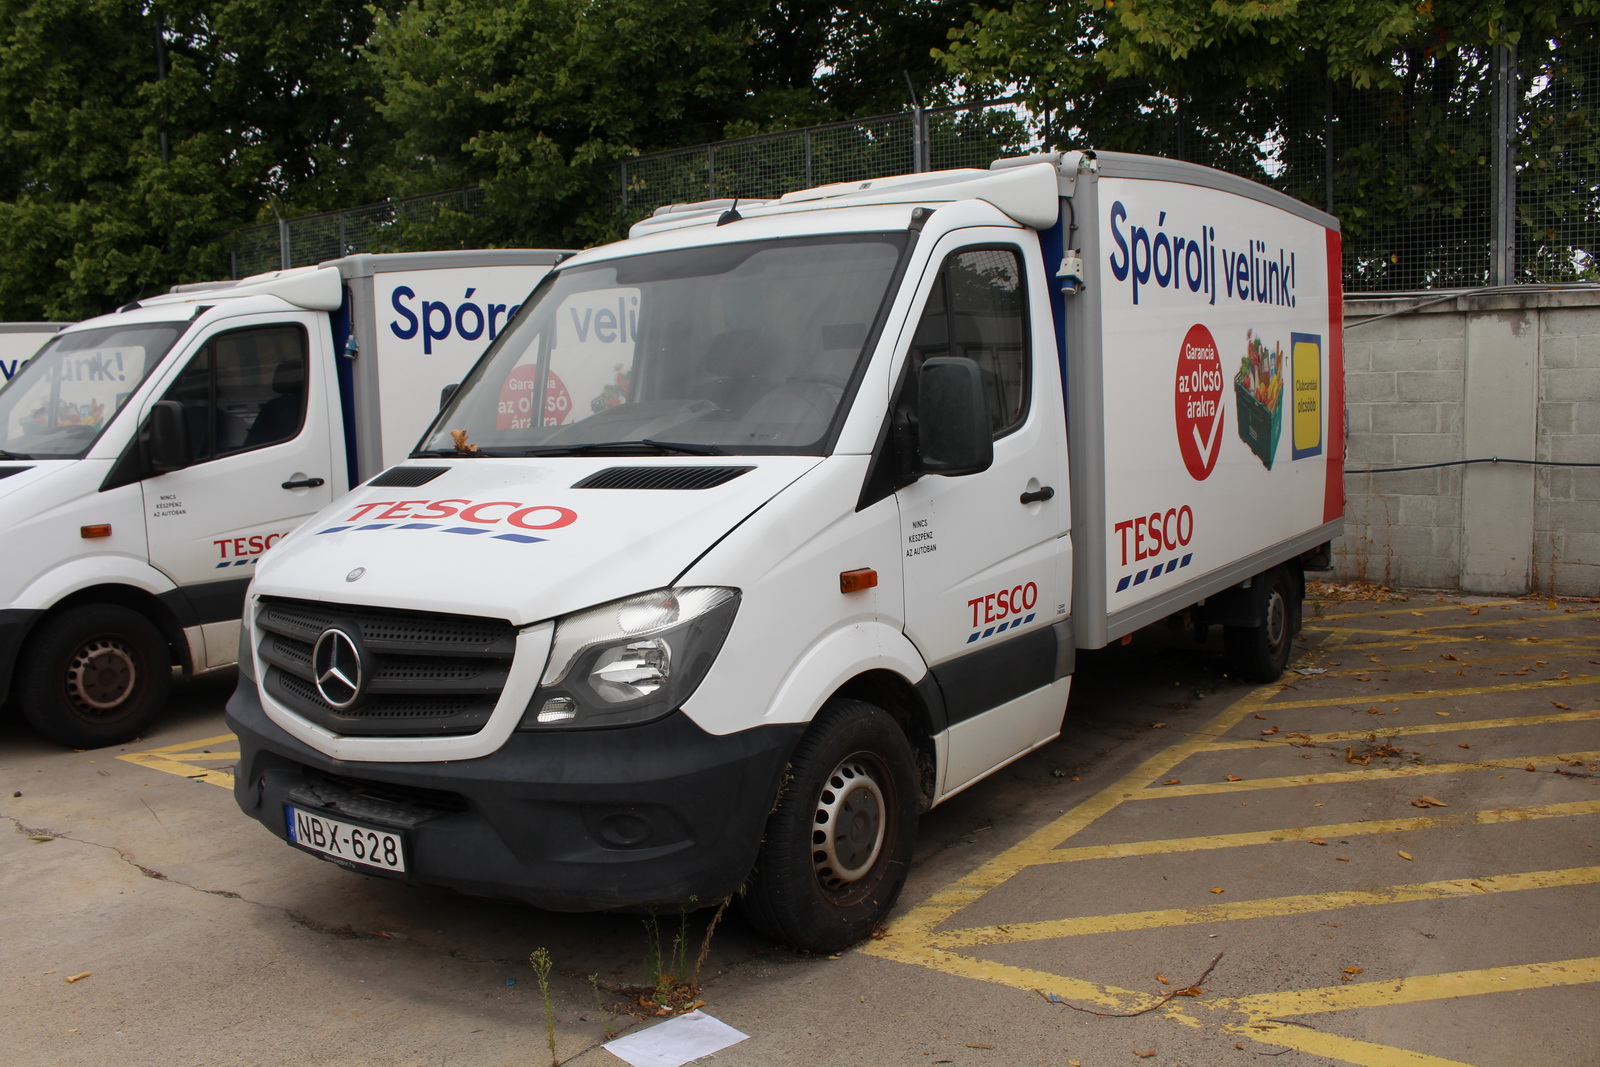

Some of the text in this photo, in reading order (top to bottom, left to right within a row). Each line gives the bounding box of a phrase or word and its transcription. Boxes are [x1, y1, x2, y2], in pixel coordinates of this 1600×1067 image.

[1110, 201, 1296, 308] Spórolj velünk!
[1185, 343, 1214, 360] Garancia
[509, 377, 556, 391] Garaia
[1179, 363, 1221, 393] az olcsó
[498, 390, 568, 414] az olsó
[1187, 395, 1215, 419] árakra
[511, 415, 558, 430] árara
[156, 501, 182, 509] KÉSZPÉNZ
[346, 499, 578, 531] TESCO
[912, 519, 928, 529] NINCS
[1115, 504, 1194, 566] TESCO
[213, 532, 290, 558] TESC
[908, 531, 933, 543] KÉSZPÉNZ
[906, 544, 937, 557] AZ AUTÓBAN
[968, 582, 1037, 627] TESCO
[297, 812, 398, 867] NBX-628
